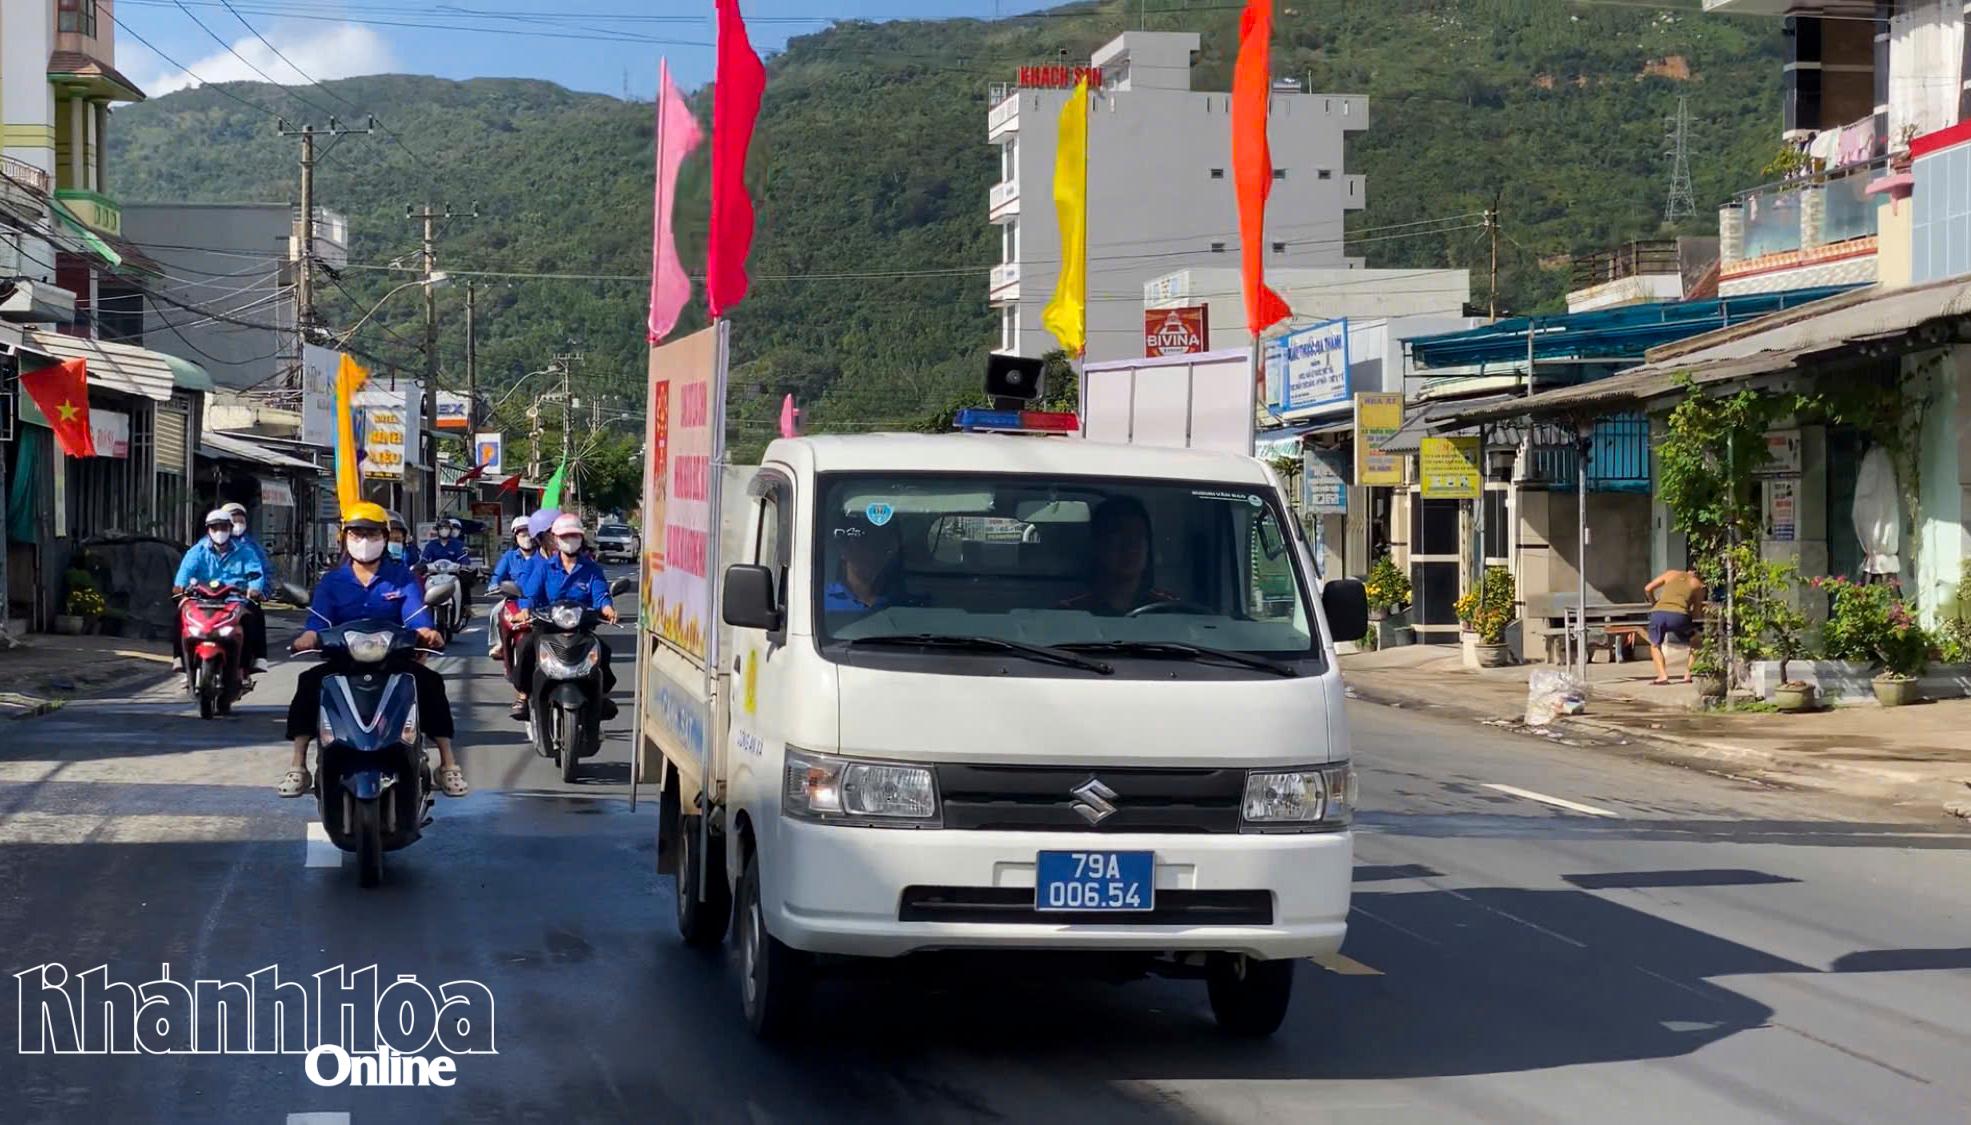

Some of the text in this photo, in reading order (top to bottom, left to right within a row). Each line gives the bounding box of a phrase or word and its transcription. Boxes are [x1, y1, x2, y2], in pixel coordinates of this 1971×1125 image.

[1147, 334, 1200, 347] BIVINA
[1071, 853, 1121, 879] 79A
[1049, 881, 1141, 908] 006.54
